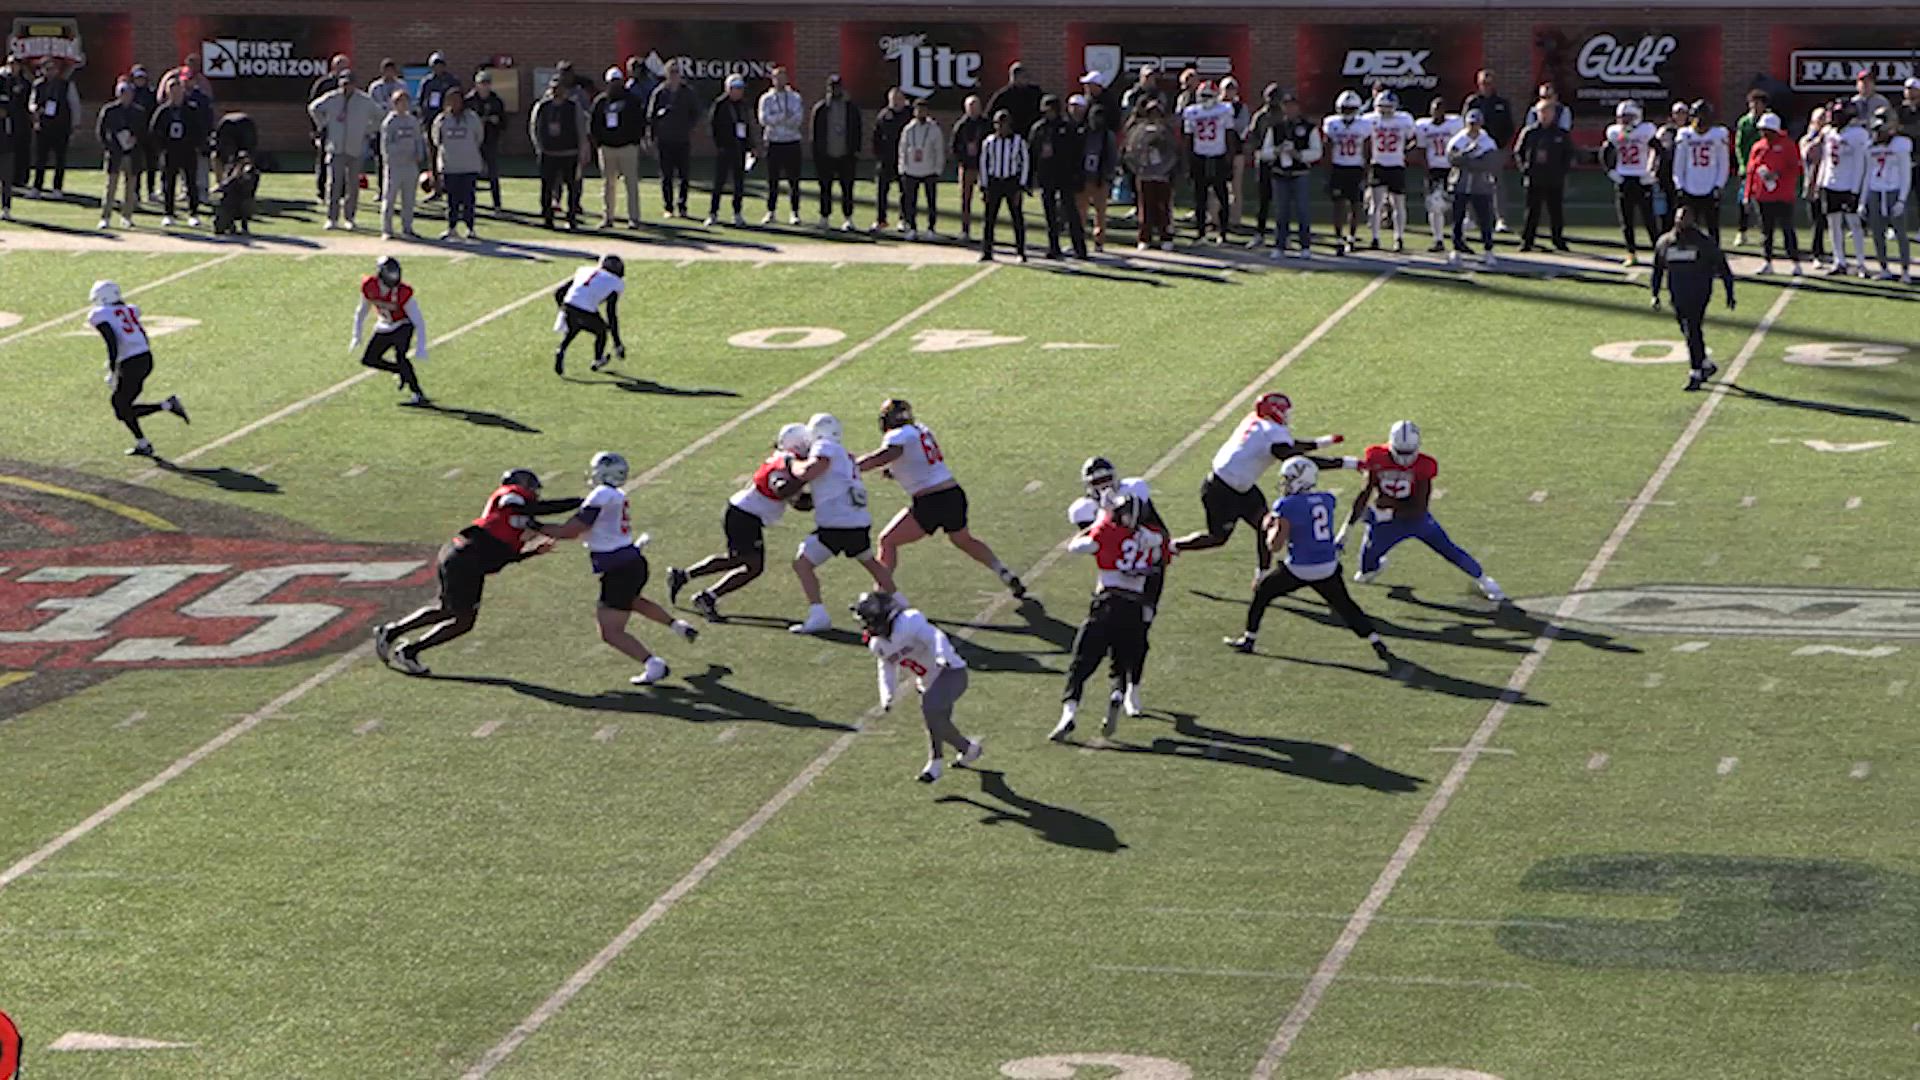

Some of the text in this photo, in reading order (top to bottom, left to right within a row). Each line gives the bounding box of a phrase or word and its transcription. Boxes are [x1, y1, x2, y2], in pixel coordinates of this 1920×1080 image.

[238, 41, 293, 58] FIRST
[1341, 50, 1431, 75] DEX
[1577, 33, 1677, 84] Gulf
[238, 59, 328, 77] HORIZON
[899, 43, 981, 98] Lite
[1312, 503, 1330, 542] 2
